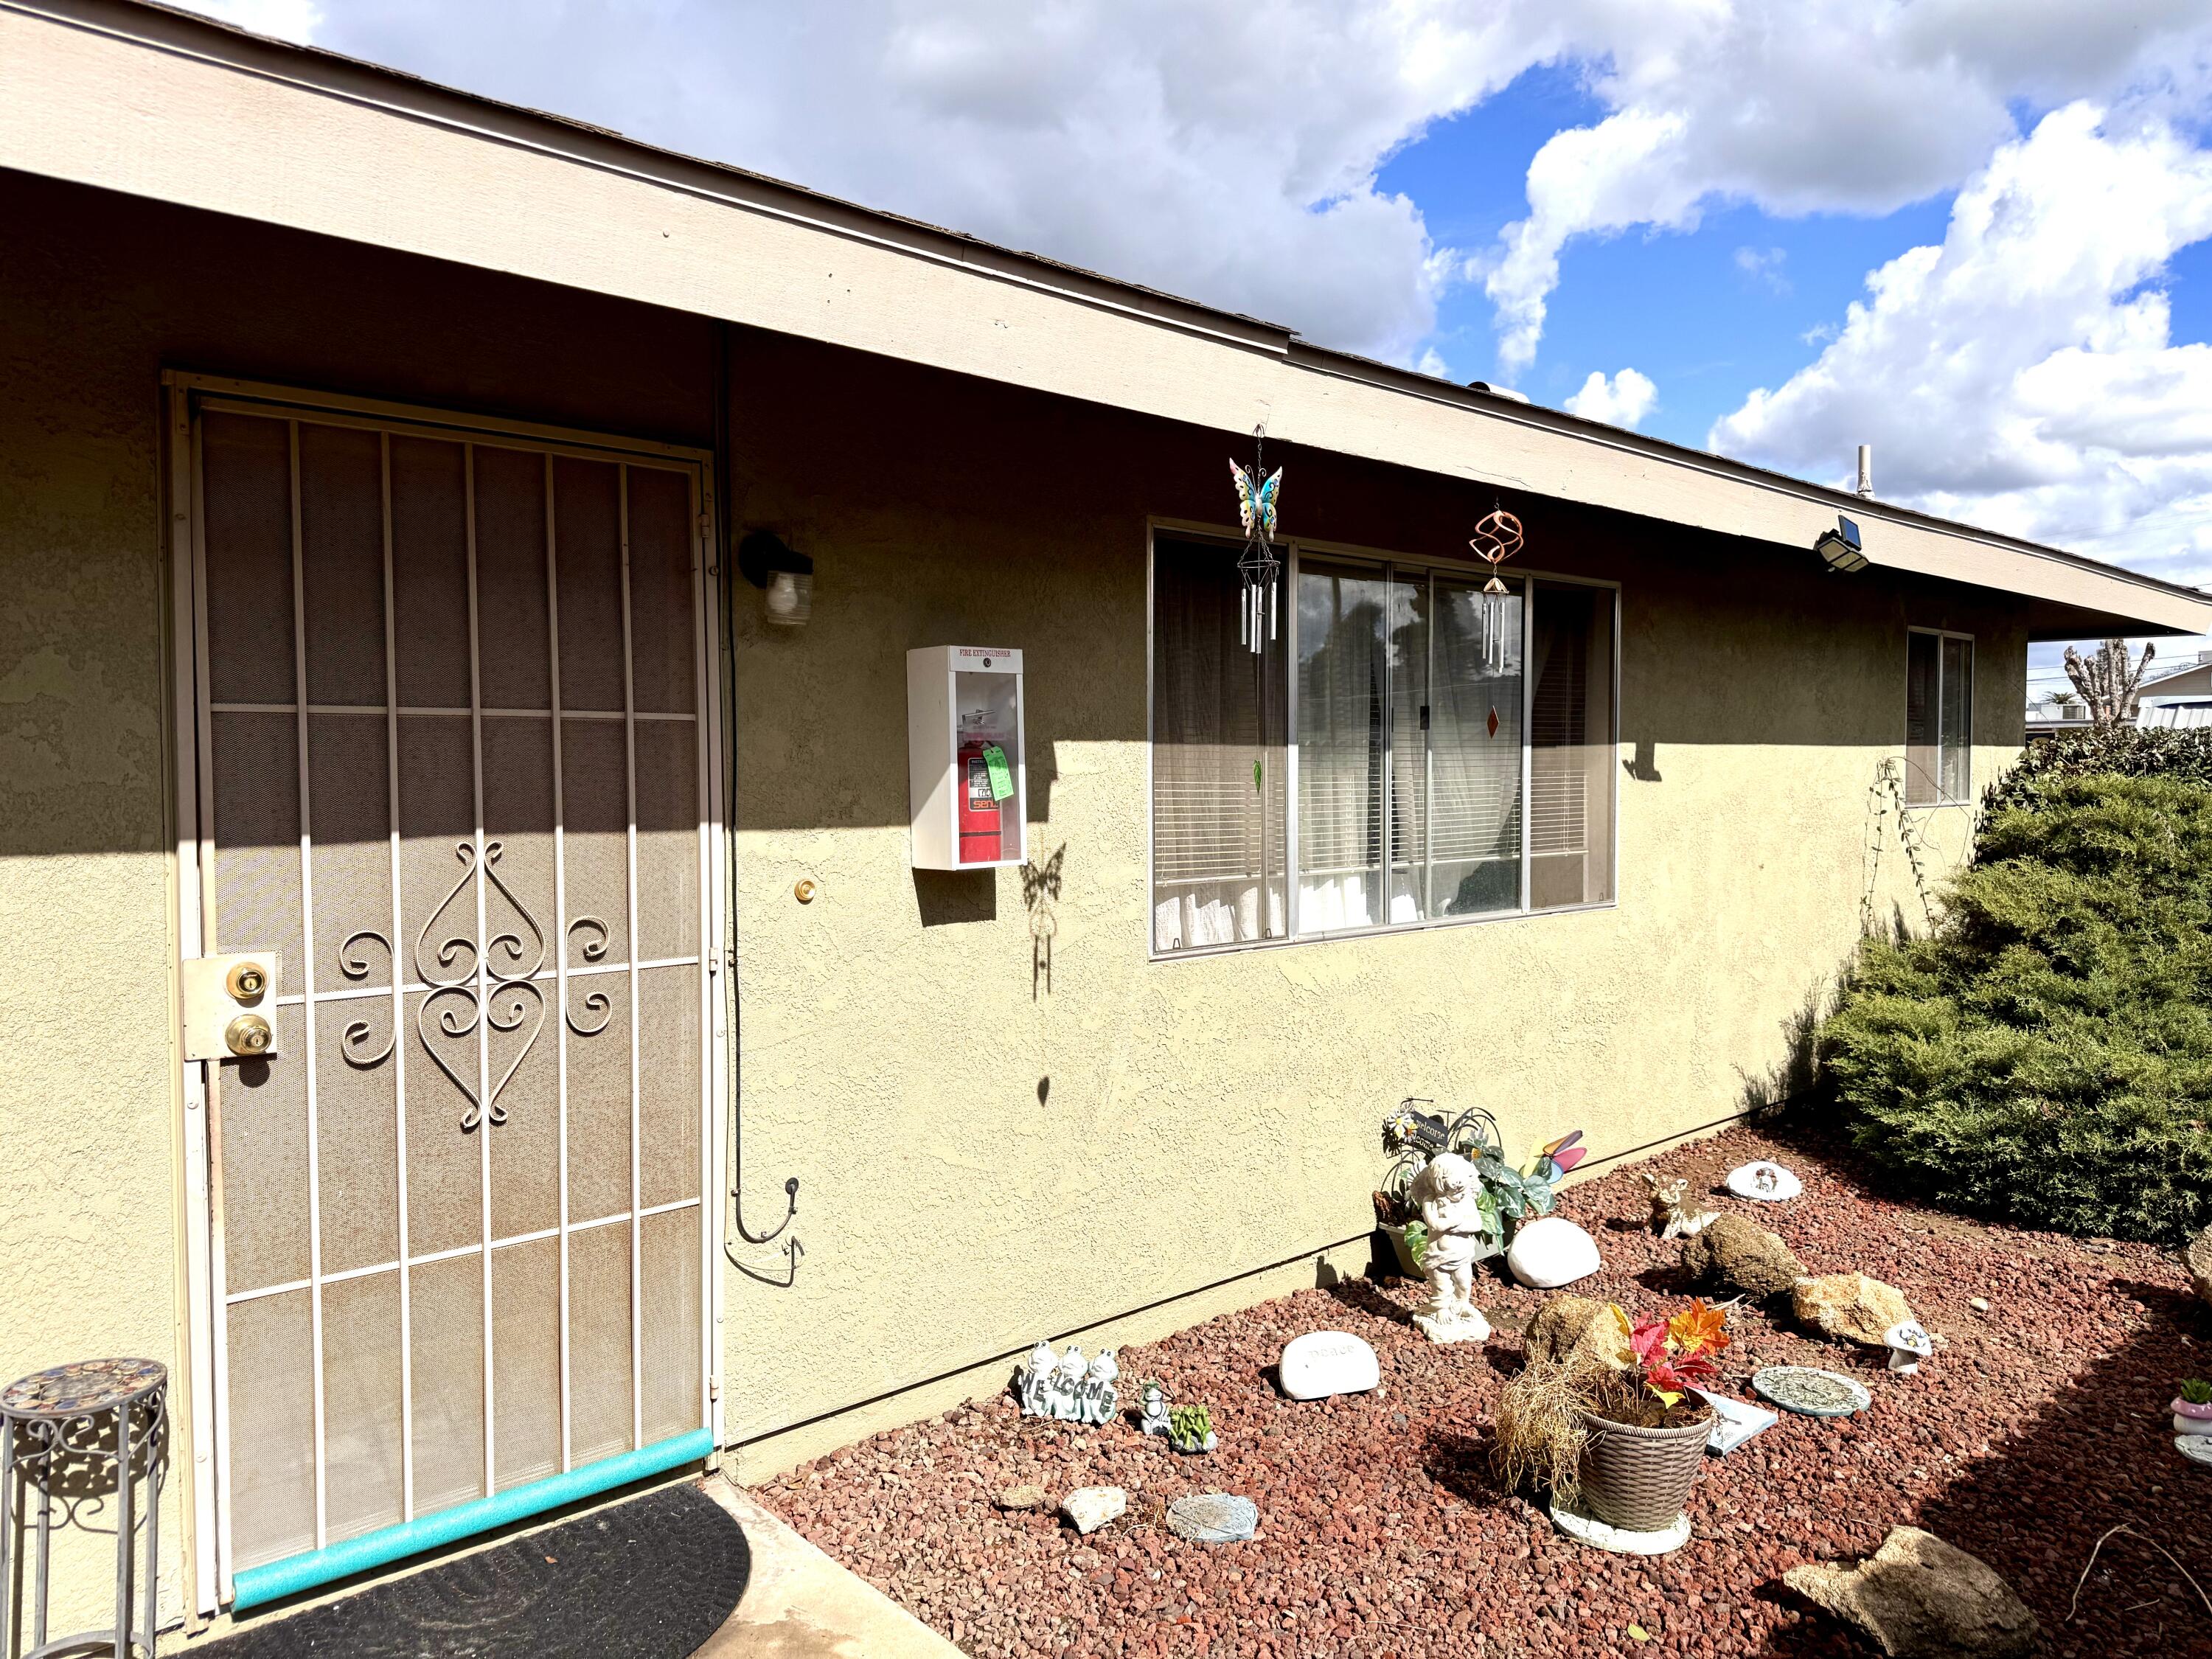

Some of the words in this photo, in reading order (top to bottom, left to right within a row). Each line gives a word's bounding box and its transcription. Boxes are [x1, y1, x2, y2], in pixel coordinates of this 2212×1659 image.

[973, 650, 1011, 658] EXTINGUISHER
[1416, 1119, 1445, 1140] welcome
[1020, 1371, 1115, 1414] WELCOME
